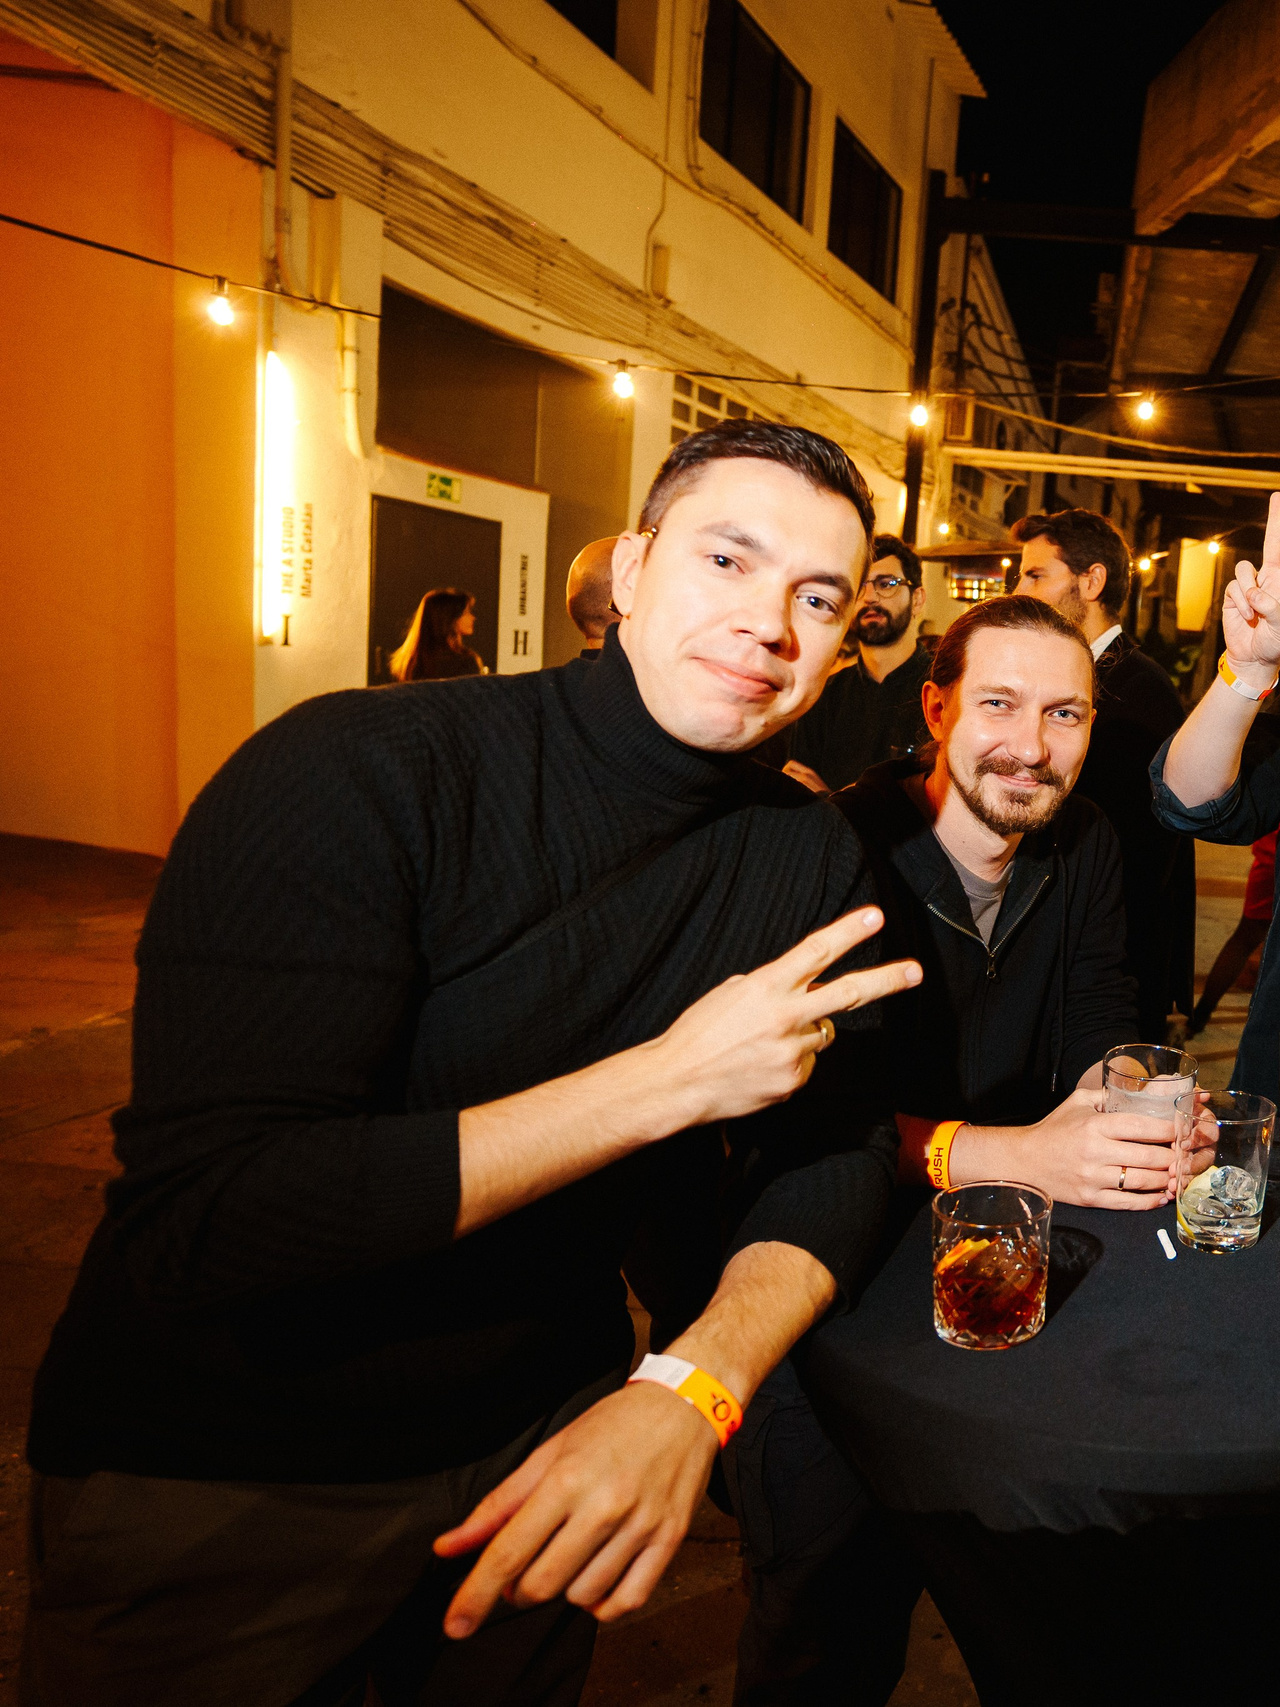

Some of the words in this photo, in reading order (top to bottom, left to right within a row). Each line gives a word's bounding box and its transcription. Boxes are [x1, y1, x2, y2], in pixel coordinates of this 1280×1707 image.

[282, 506, 294, 553] STUDIO
[281, 558, 293, 568] A
[281, 572, 293, 594] THE
[513, 630, 528, 655] H
